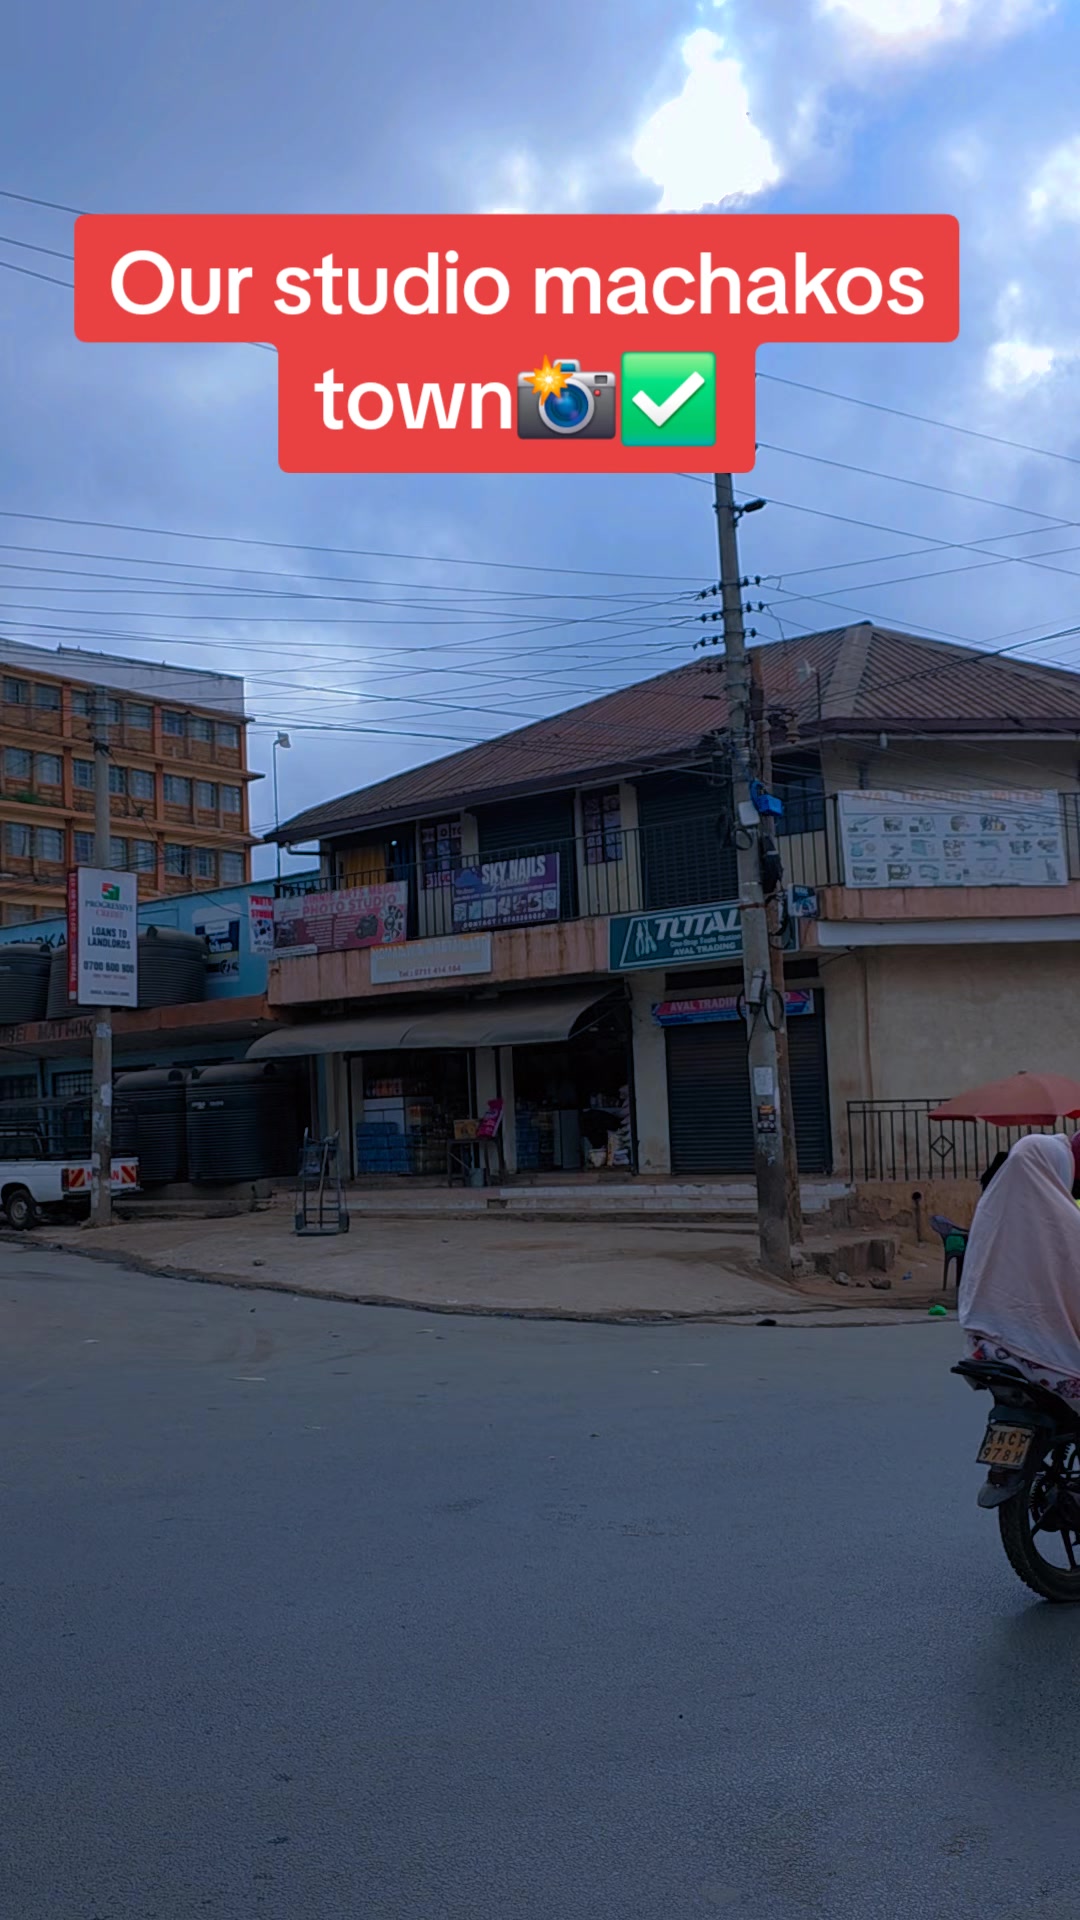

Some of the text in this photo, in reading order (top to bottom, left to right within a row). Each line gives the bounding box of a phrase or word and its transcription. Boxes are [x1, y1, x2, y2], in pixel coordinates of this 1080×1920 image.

[481, 860, 507, 886] SKY
[509, 854, 546, 880] NAILS
[85, 900, 133, 912] PROGRESSIVE
[303, 900, 344, 915] PHOTO
[348, 894, 396, 912] STUDIO
[91, 926, 128, 938] LOANS TO
[87, 937, 131, 950] LANDLORDS
[673, 941, 736, 957] AVAL TRADING
[83, 960, 104, 971] 0700
[670, 997, 742, 1013] AVAL TRADIN
